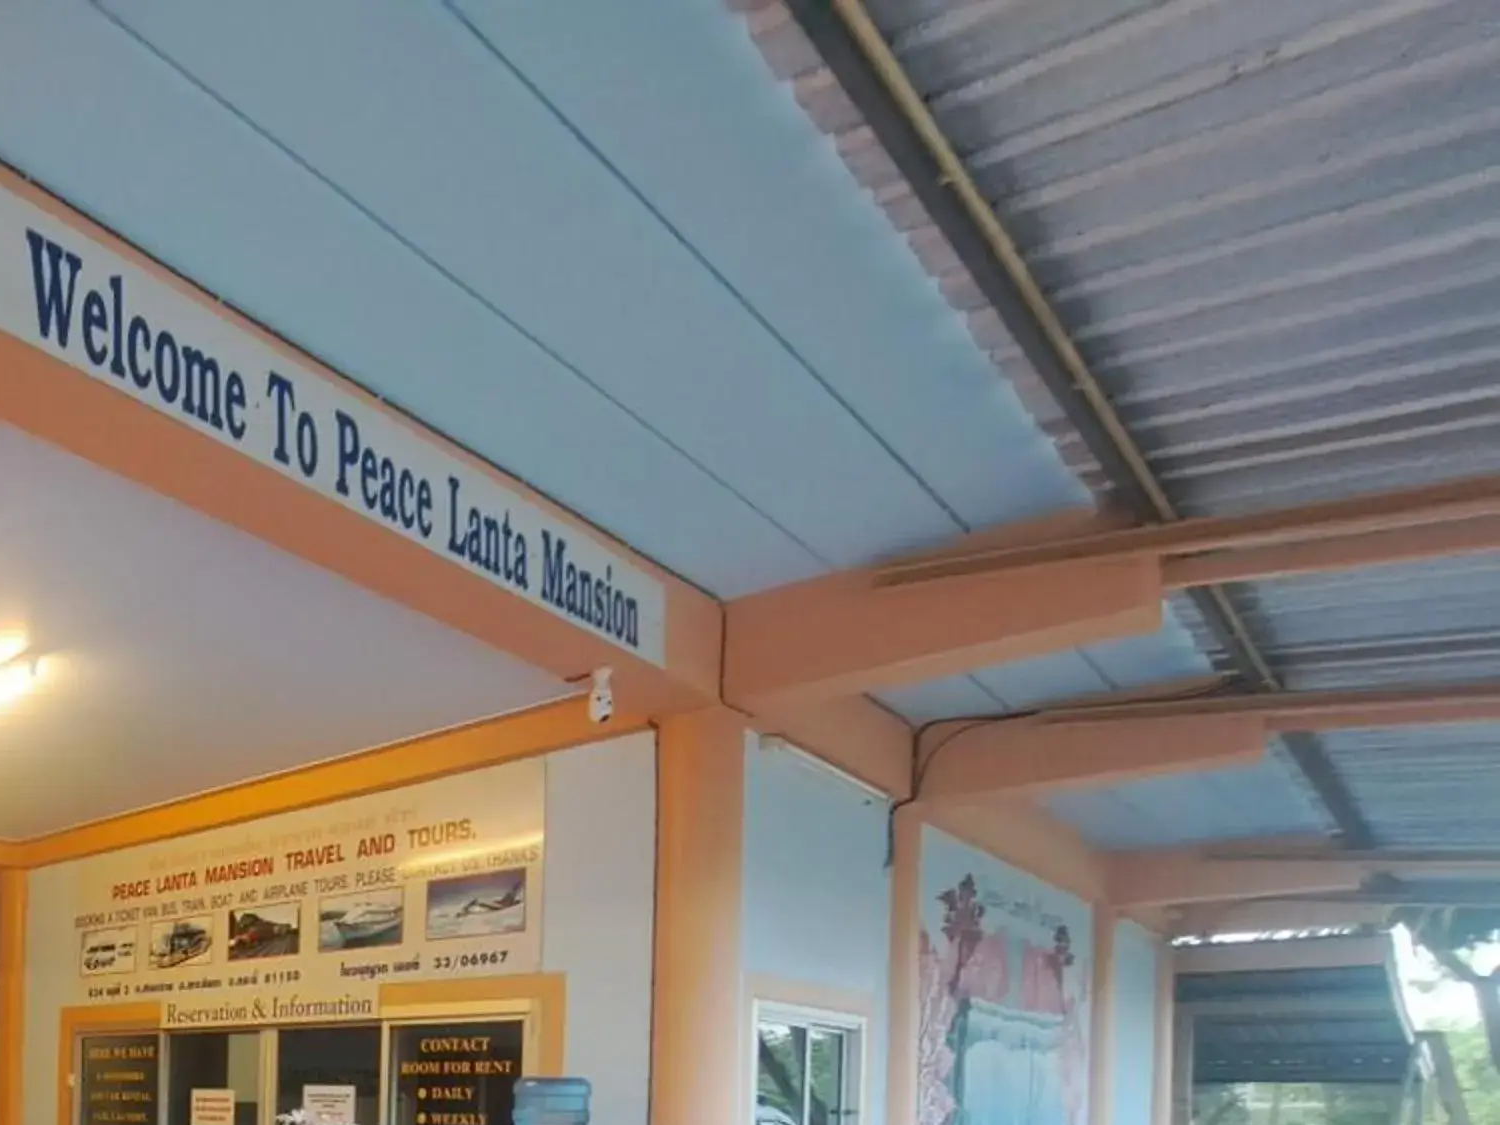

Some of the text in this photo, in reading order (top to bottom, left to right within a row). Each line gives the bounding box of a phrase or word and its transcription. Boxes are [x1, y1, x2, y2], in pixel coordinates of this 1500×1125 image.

[25, 226, 639, 649] Welcome To Peace Lanta Mansion
[112, 880, 151, 900] PEACE
[156, 871, 197, 895] LANTA
[204, 857, 274, 884] MANSION
[286, 843, 345, 872] TRAVEL
[357, 833, 395, 859] AND
[355, 866, 397, 887] PLEASE
[166, 994, 373, 1025] Reservation & Information
[420, 1037, 490, 1052] CONTACT
[401, 1060, 513, 1075] ROOM FOR RENT
[431, 1087, 474, 1101] DAILY
